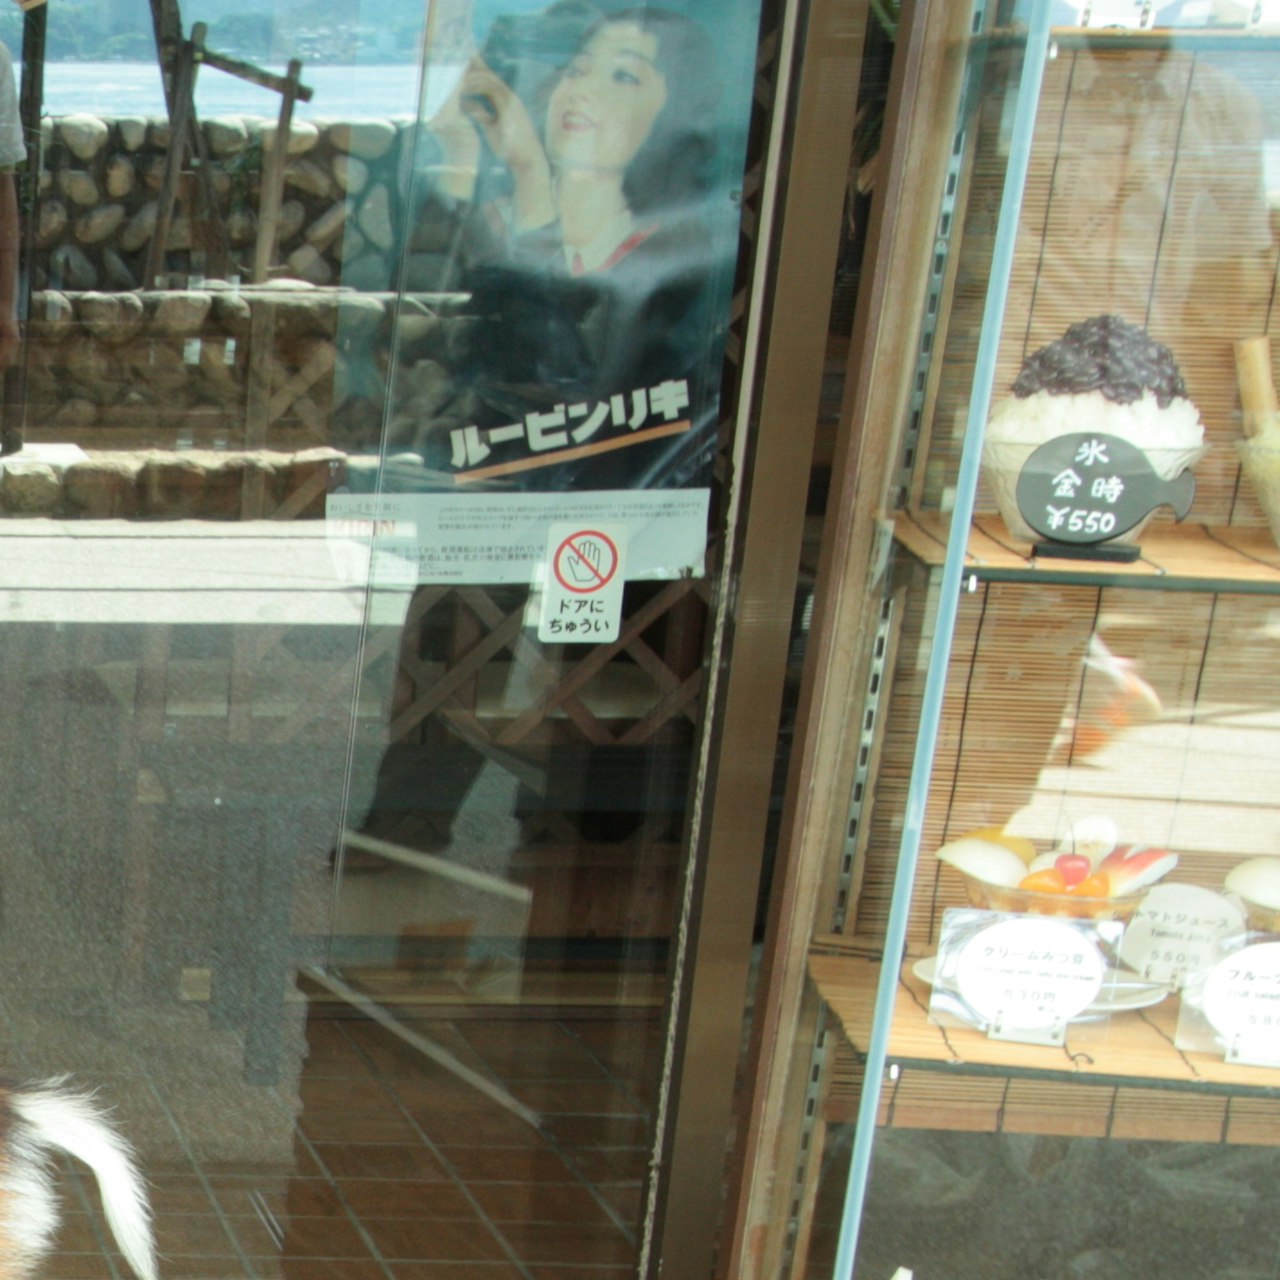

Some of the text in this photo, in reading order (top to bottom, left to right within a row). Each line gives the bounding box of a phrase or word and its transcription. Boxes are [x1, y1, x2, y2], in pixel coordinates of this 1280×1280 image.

[1074, 438, 1109, 466] 氷
[1051, 468, 1124, 503] 金時
[1046, 504, 1116, 534] ¥550
[559, 598, 604, 614] ドアに
[549, 618, 610, 634] ちゅうい
